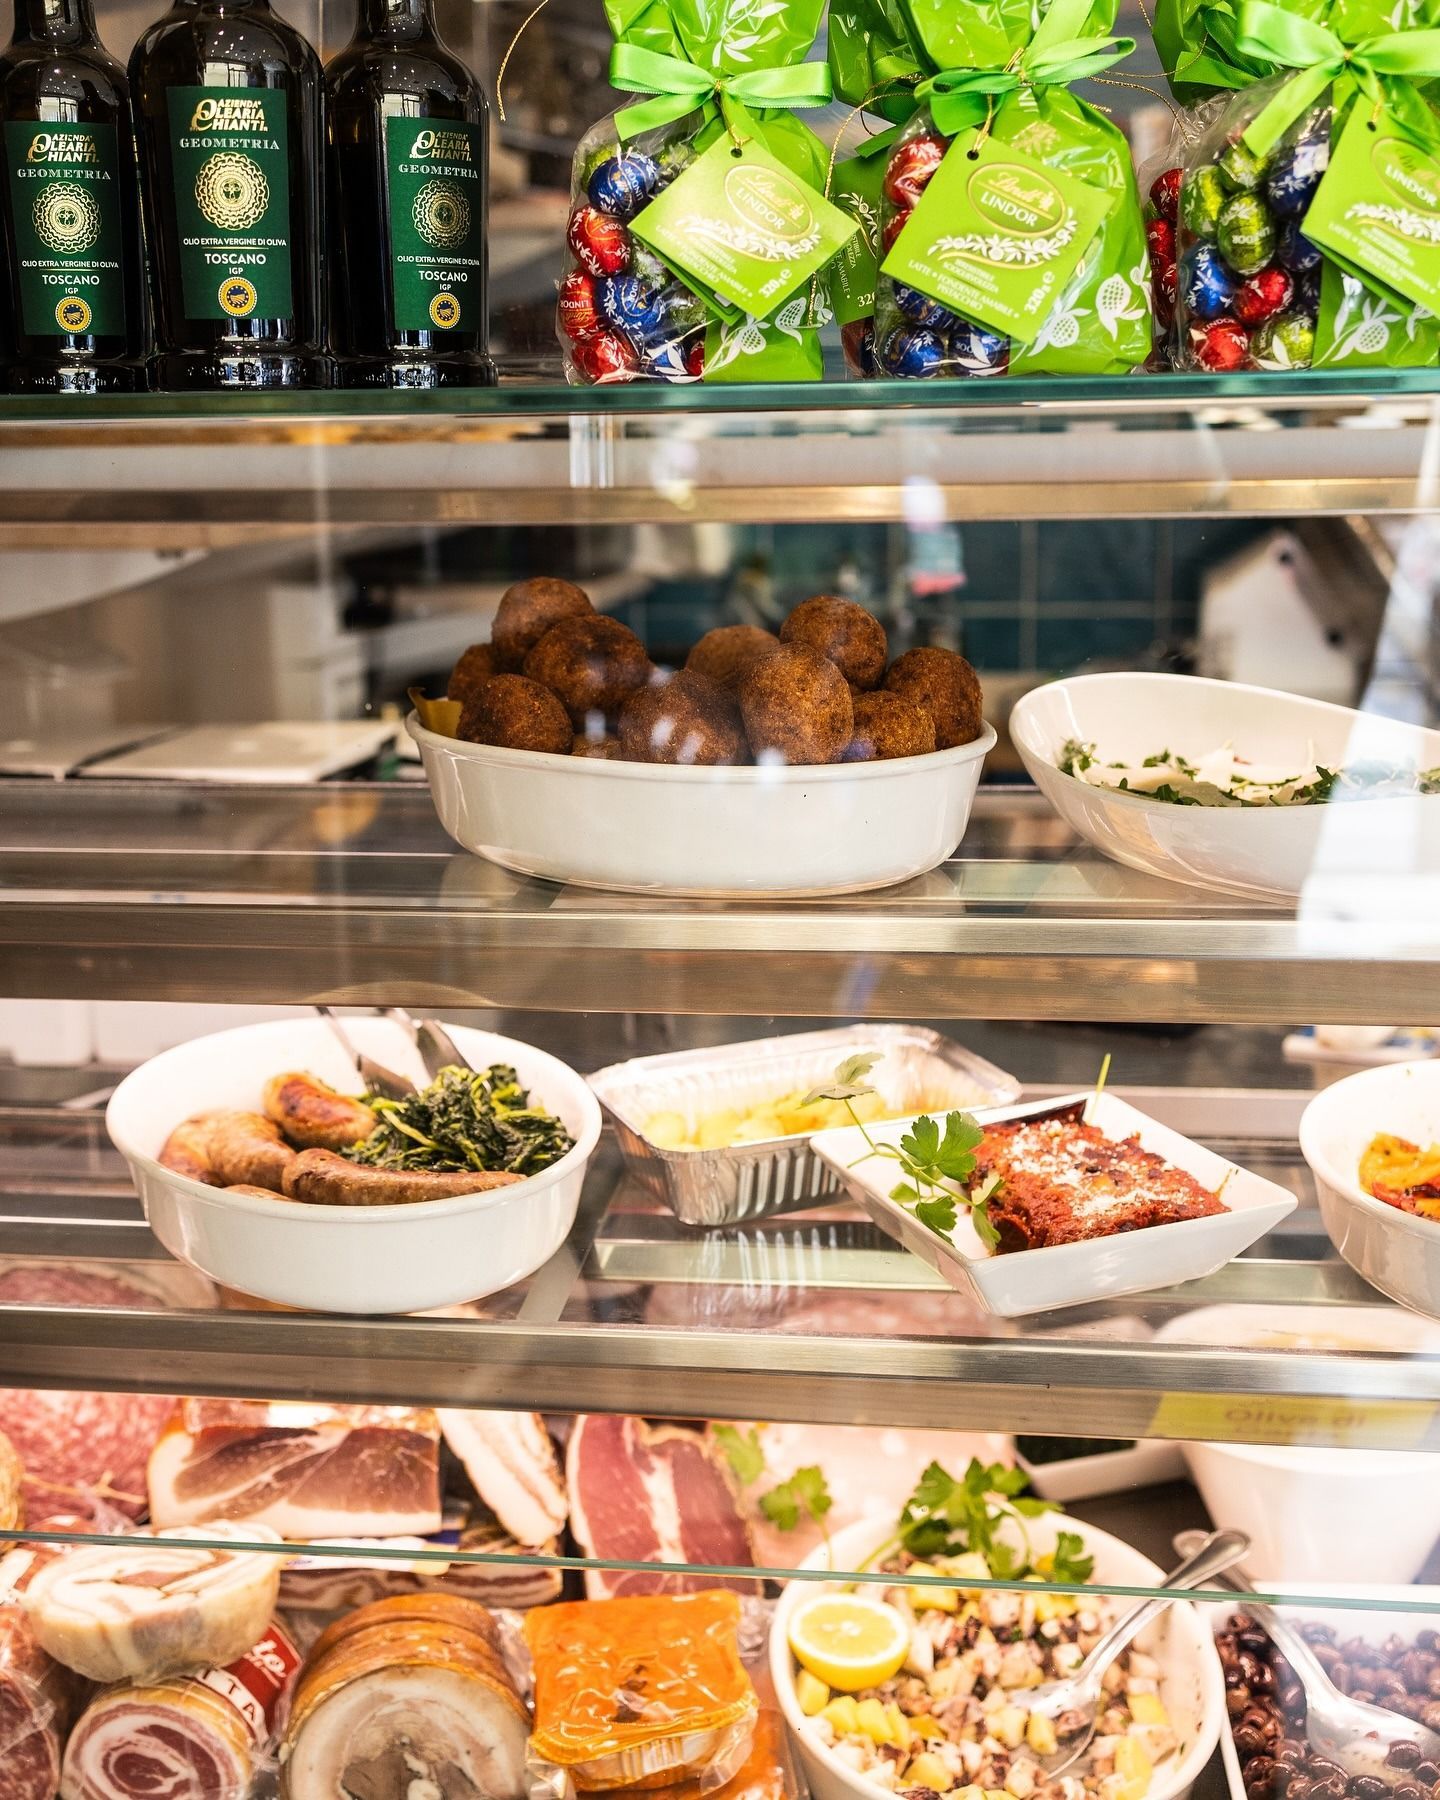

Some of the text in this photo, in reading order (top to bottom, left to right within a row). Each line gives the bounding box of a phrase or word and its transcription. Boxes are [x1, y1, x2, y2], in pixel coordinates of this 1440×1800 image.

[180, 138, 280, 150] GEOMETRIA
[16, 168, 111, 180] GEOMETRIA
[398, 164, 478, 179] GEOMETRIA
[1385, 164, 1438, 207] LINDOR
[736, 188, 786, 230] LINDOR
[980, 190, 1038, 227] LINDOR
[204, 254, 266, 264] TOSCANO
[436, 257, 462, 265] VERGINE
[42, 274, 100, 285] TOSCANO
[418, 270, 468, 282] TOSCANO
[560, 300, 589, 309] LINDOR
[1224, 1408, 1367, 1428] Olive di
